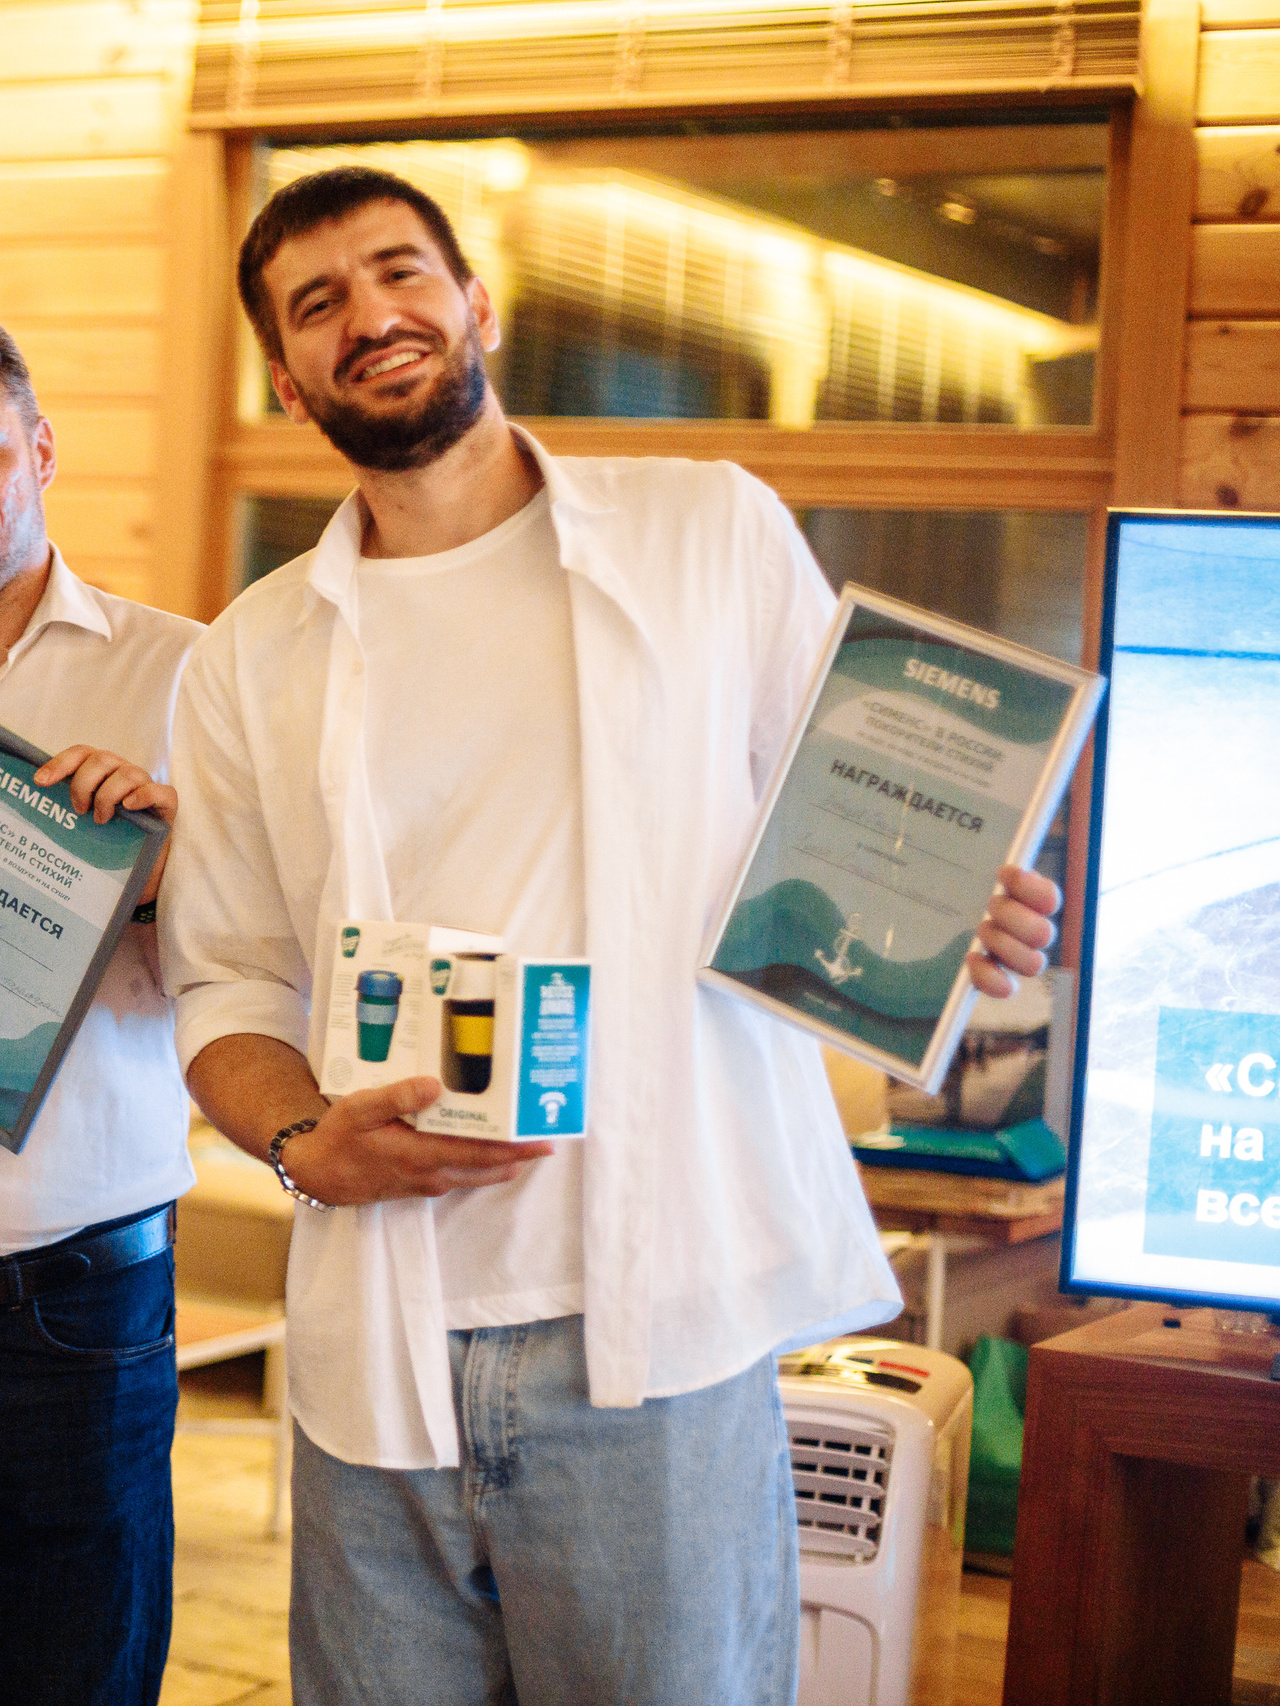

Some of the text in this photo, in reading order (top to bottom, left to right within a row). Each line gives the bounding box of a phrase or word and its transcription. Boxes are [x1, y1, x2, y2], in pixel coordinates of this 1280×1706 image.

[903, 658, 1001, 709] SIEMENS
[830, 759, 985, 833] НАГРАЖДАЕТСЯ
[18, 836, 27, 845] В
[29, 842, 83, 882] РОССИИ:
[28, 855, 73, 888] СТИХИЙ
[1205, 1053, 1280, 1097] «С
[1200, 1124, 1264, 1161] на
